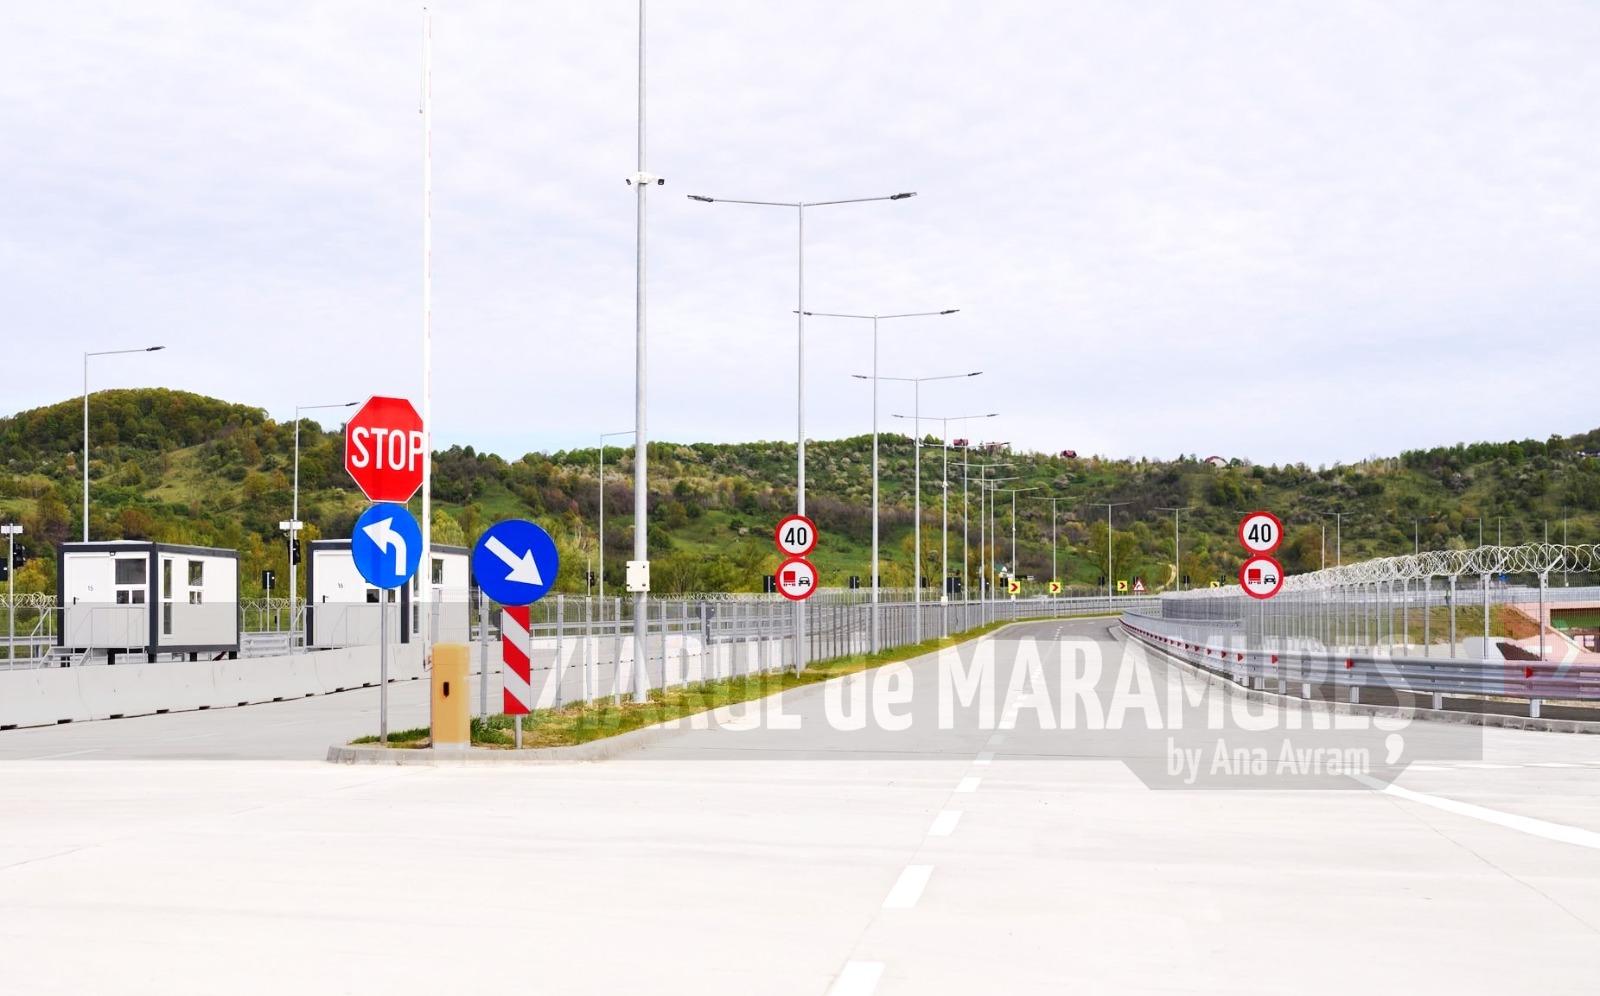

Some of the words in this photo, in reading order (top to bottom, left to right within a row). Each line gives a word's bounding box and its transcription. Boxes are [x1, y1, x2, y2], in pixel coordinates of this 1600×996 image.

[351, 426, 424, 472] STOP
[784, 527, 807, 546] 40
[1248, 523, 1272, 543] 40
